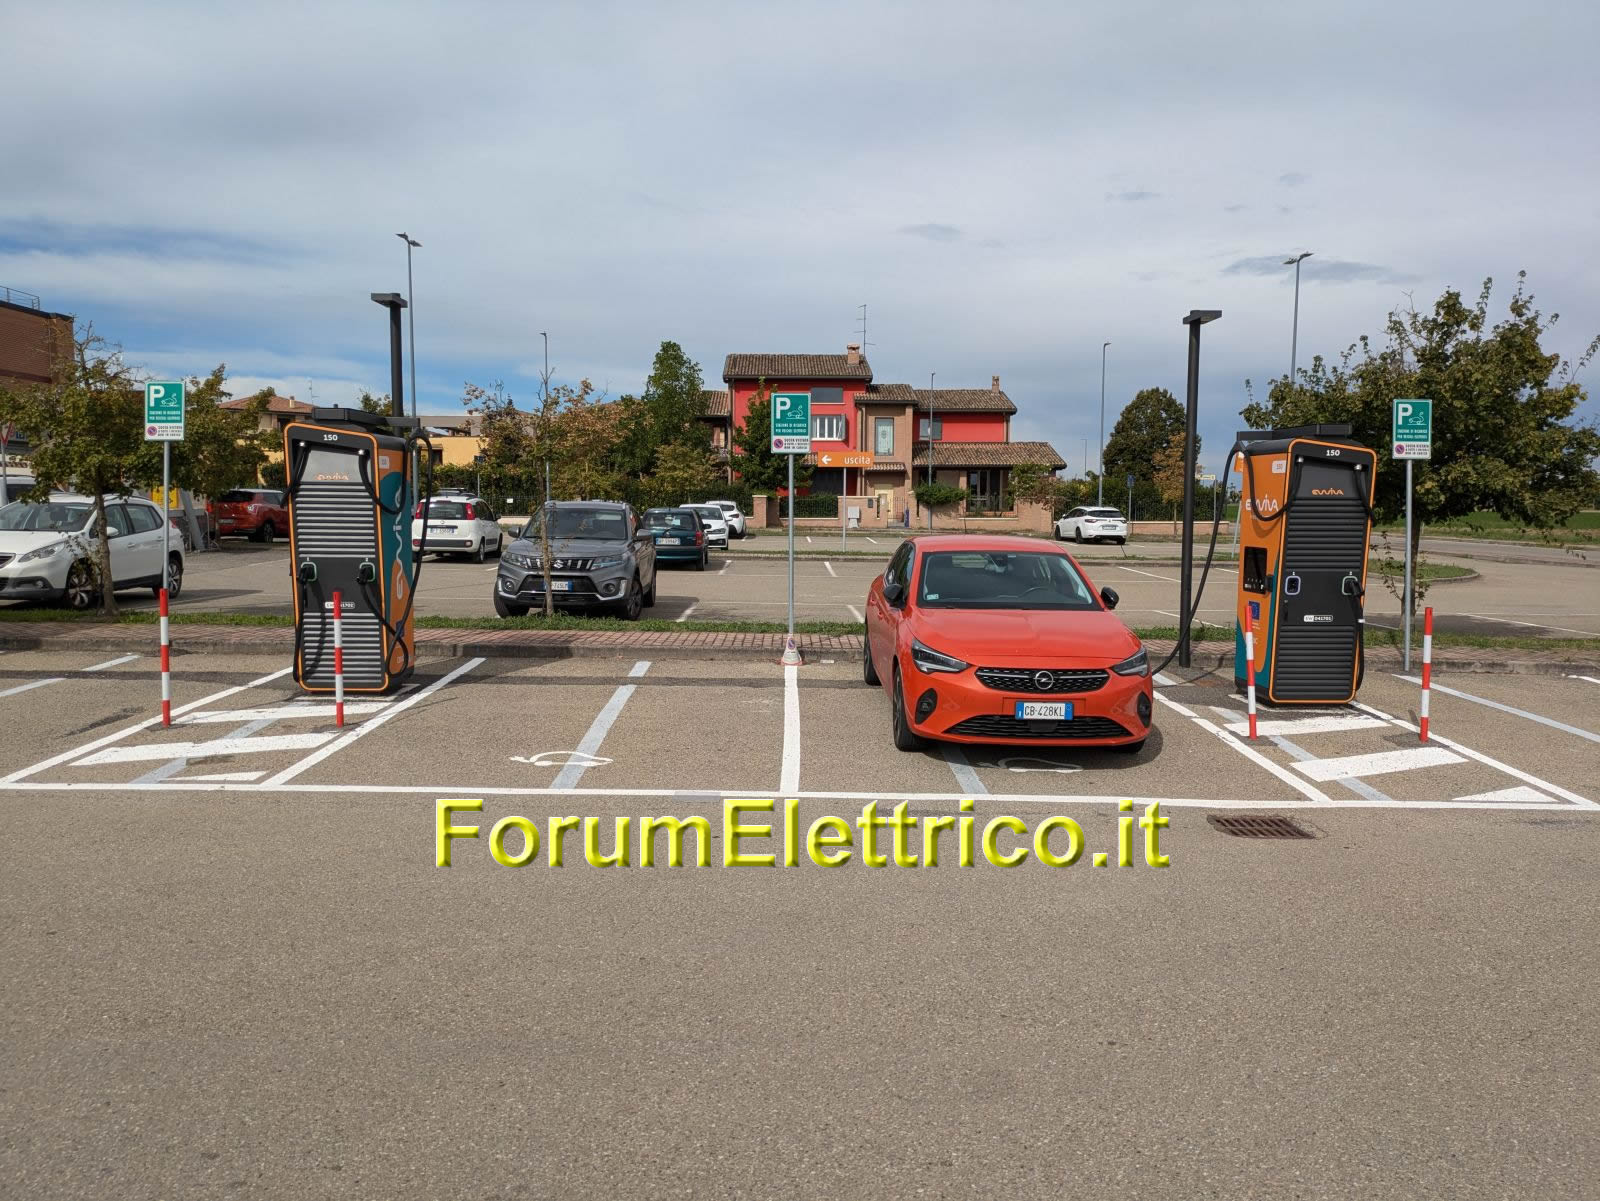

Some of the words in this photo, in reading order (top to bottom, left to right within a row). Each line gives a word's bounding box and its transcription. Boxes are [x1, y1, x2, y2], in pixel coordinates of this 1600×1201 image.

[150, 385, 165, 407] P
[776, 397, 791, 419] P
[1398, 404, 1413, 425] P
[844, 456, 871, 465] uscita
[1326, 449, 1341, 457] 150
